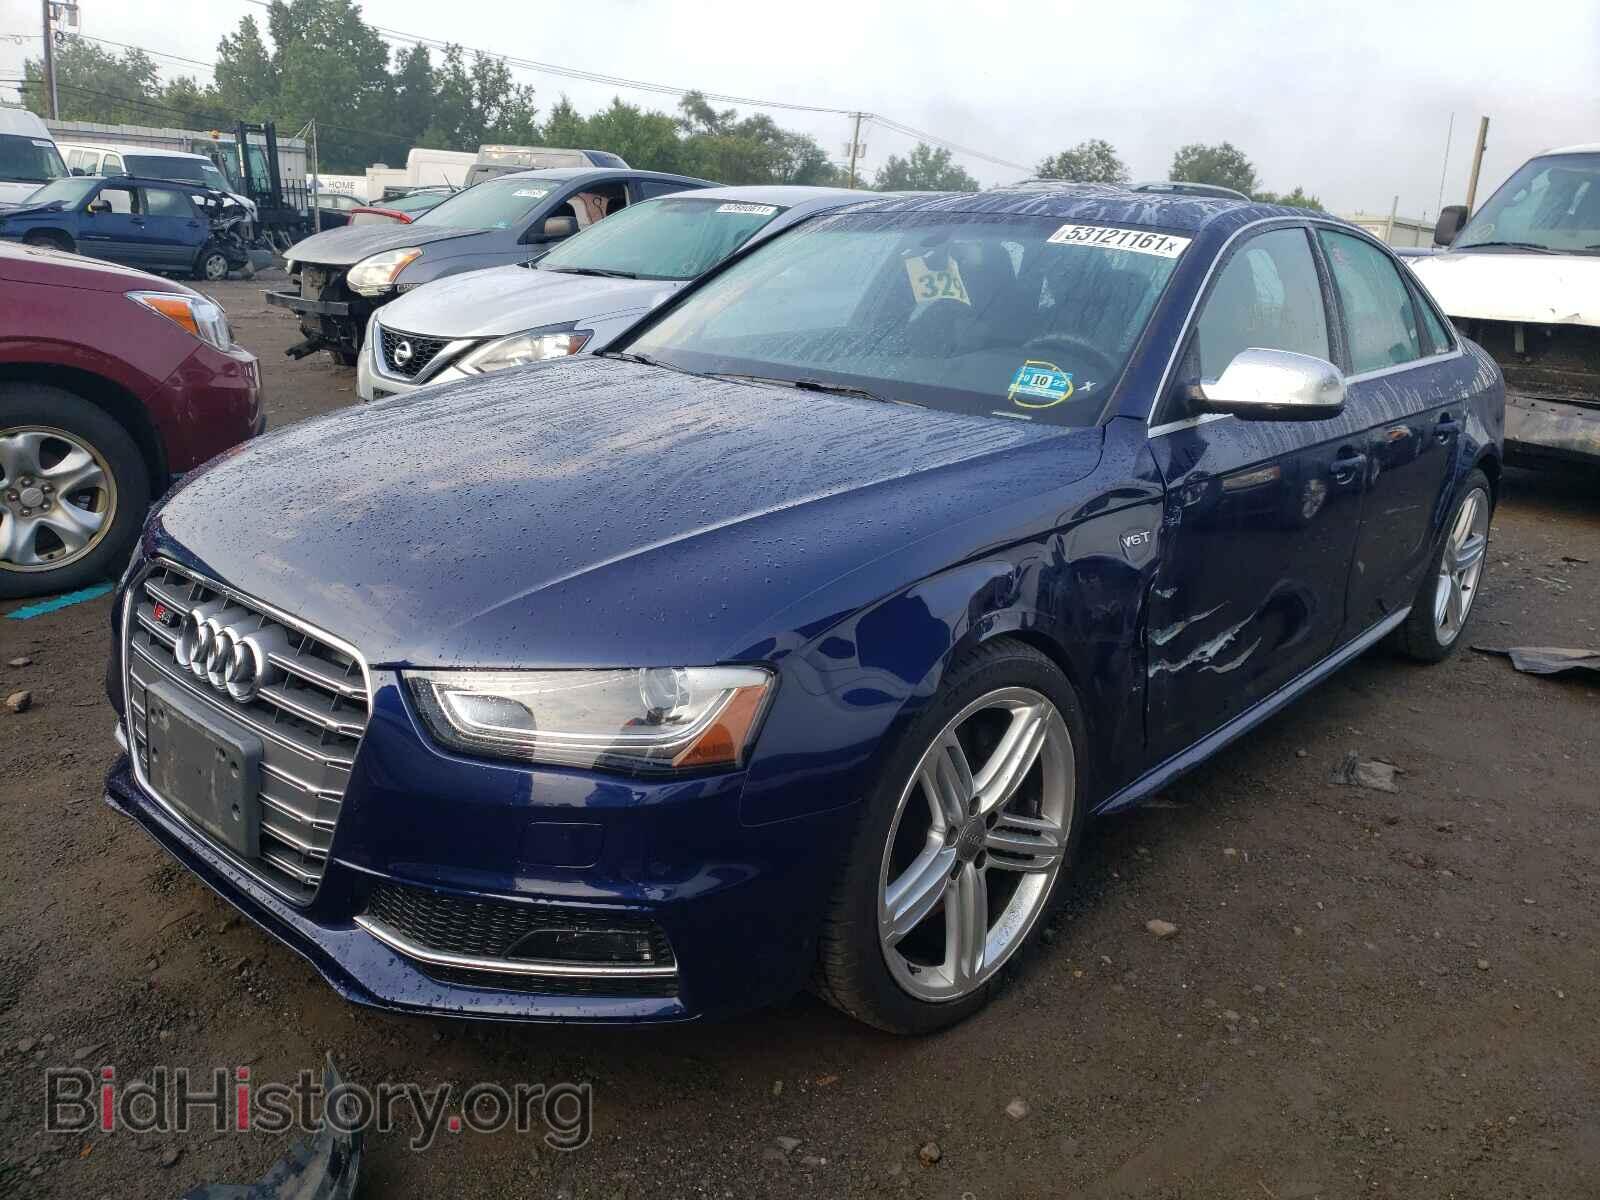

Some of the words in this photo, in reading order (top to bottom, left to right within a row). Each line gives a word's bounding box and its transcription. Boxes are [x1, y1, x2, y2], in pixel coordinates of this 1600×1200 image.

[328, 181, 356, 190] HOME
[1032, 375, 1049, 386] 10
[1122, 531, 1151, 547] V6T
